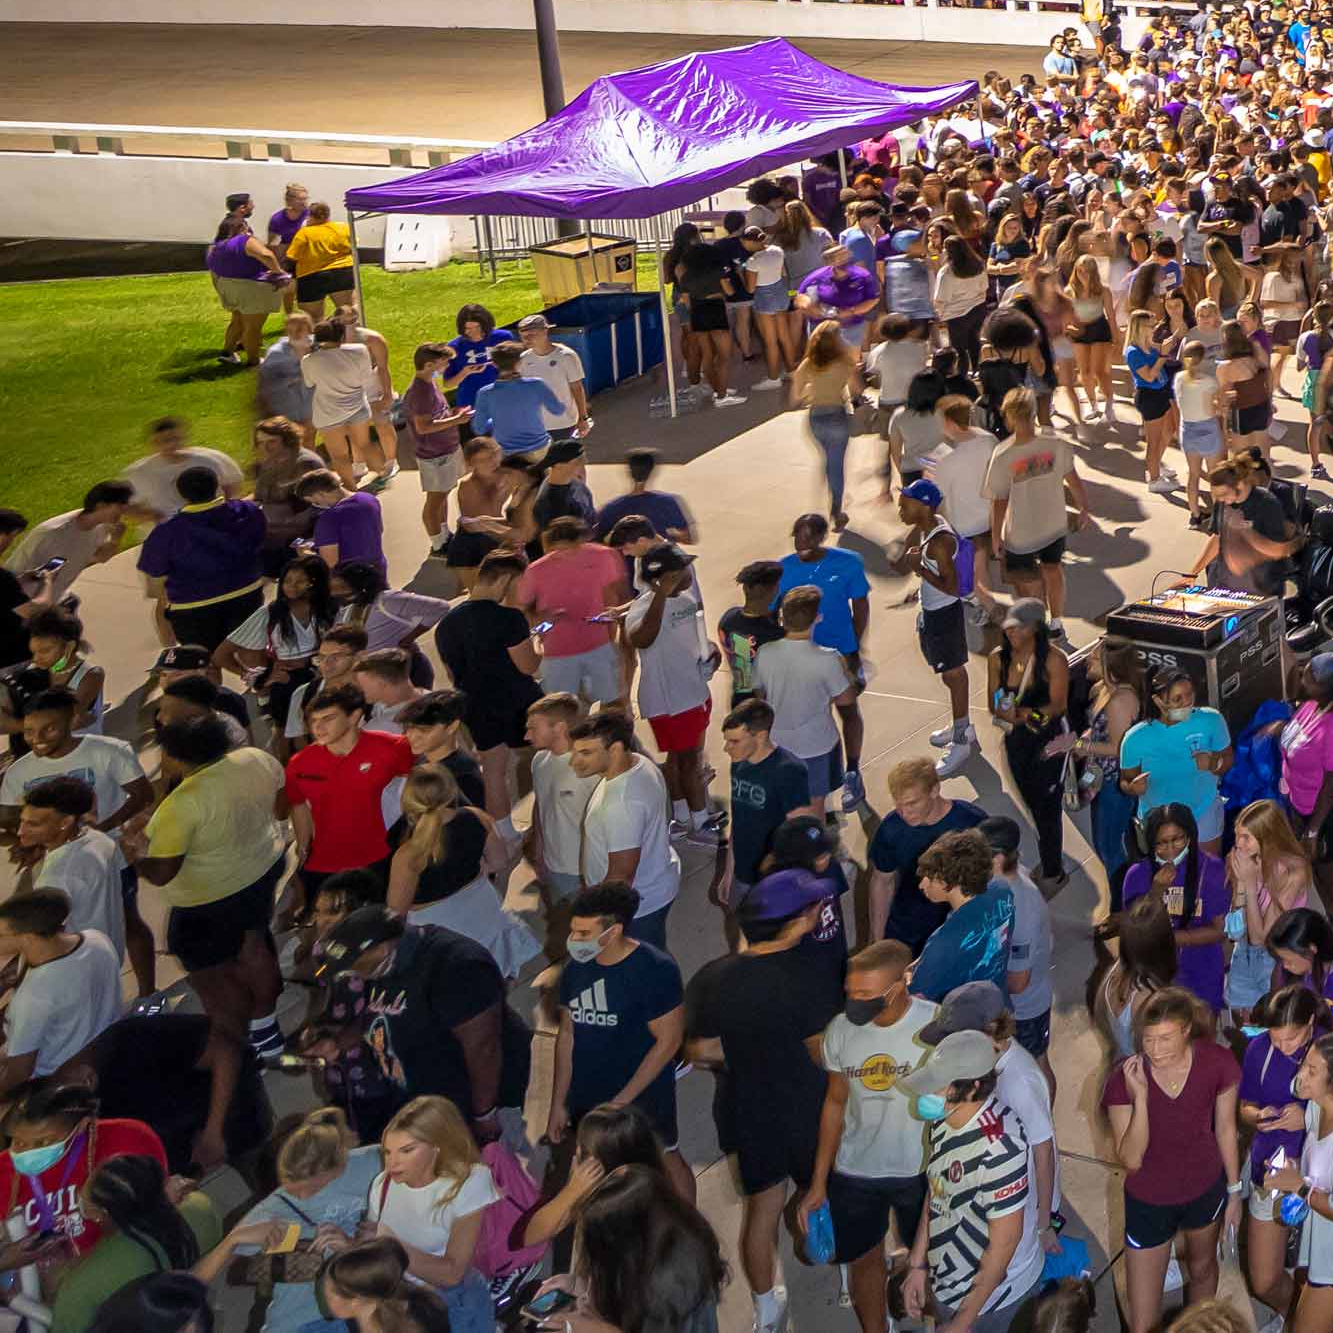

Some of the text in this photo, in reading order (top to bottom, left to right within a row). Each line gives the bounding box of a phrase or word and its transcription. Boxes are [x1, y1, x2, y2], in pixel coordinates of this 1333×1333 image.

[1239, 639, 1264, 665] PSS
[569, 1009, 619, 1027] didas
[845, 1060, 912, 1079] Hard Rock
[993, 1176, 1029, 1200] KOHLE
